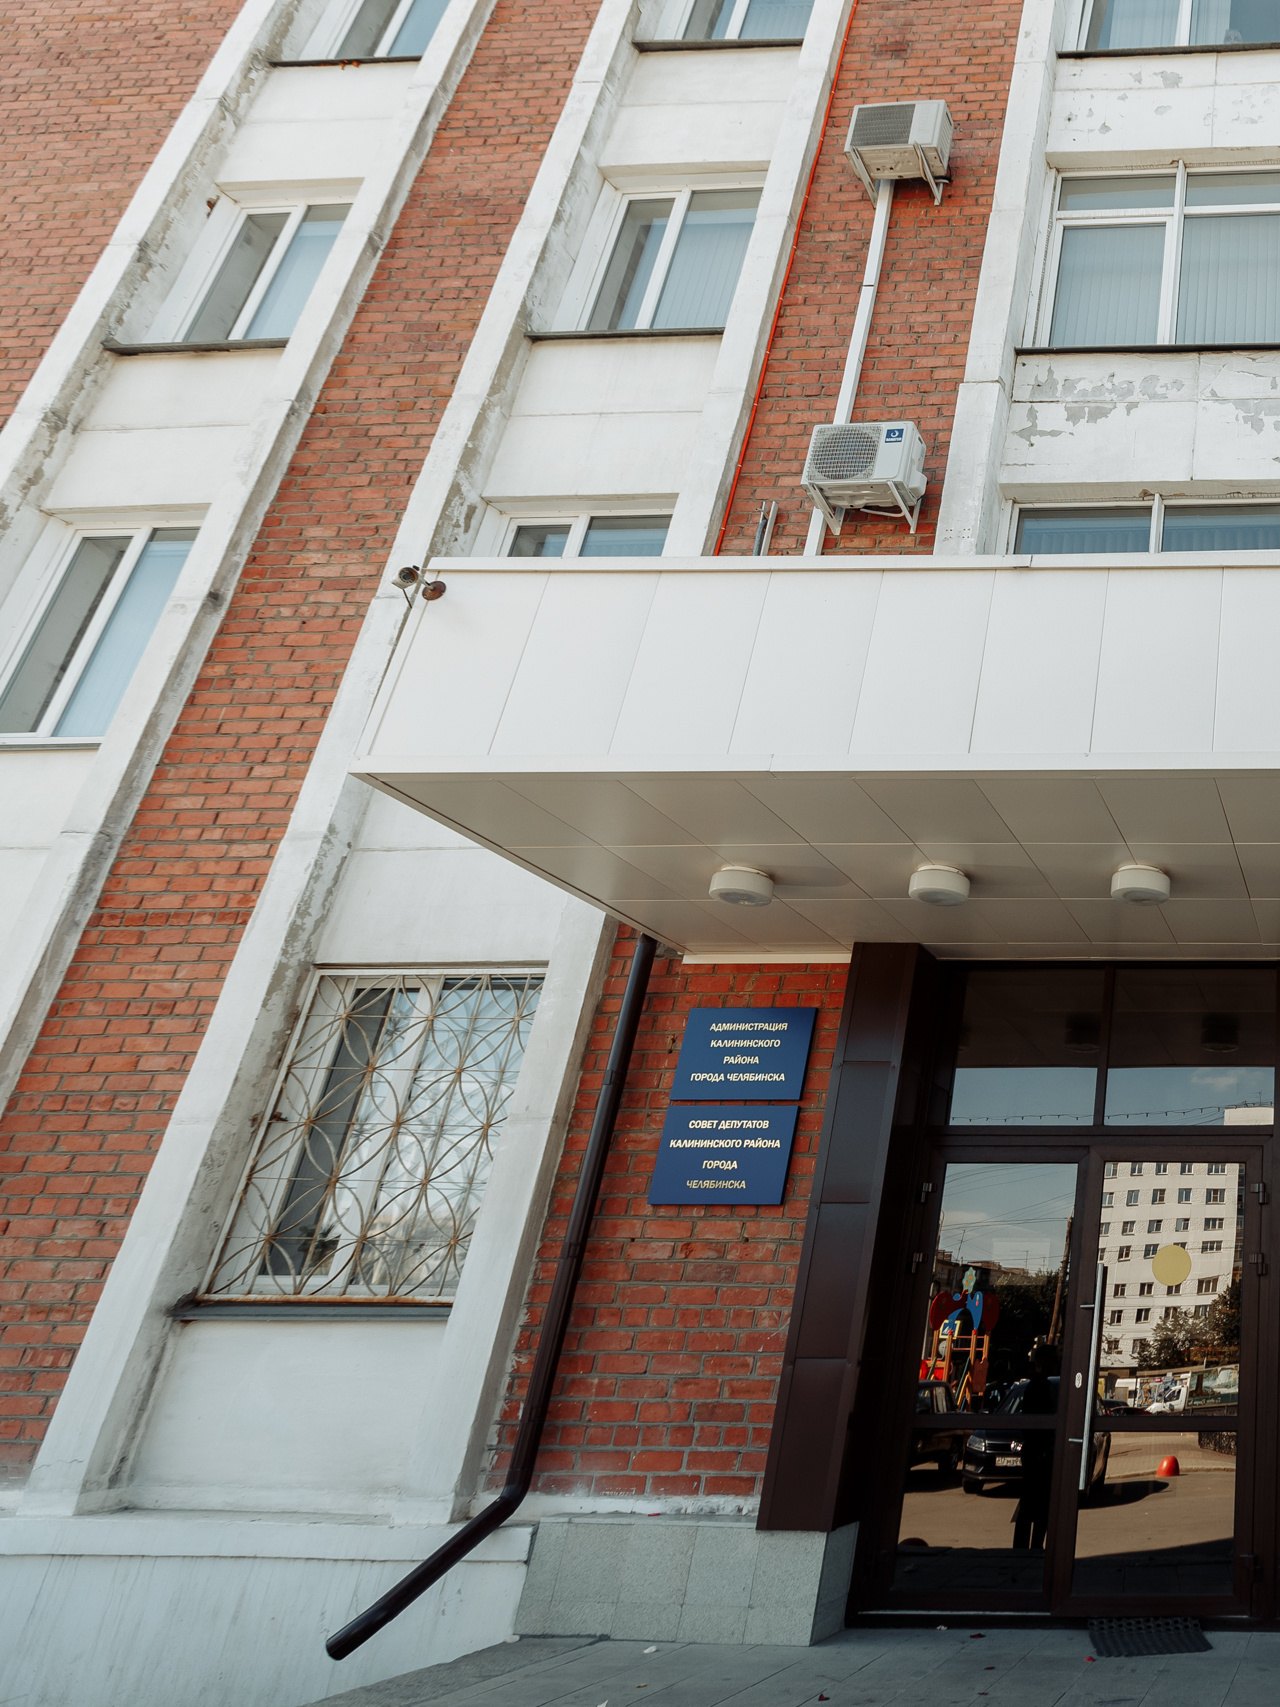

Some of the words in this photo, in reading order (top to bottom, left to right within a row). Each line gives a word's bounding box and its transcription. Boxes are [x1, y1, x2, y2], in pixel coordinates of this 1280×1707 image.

[710, 1023, 788, 1032] АДМИНИСТРАЦИЯ
[710, 1040, 780, 1048] КАЛИНИНСКОГО
[723, 1055, 759, 1064] РАЙОНА
[690, 1073, 724, 1082] ГОРОДА
[727, 1073, 785, 1081] ЧЕЛЯБИНСКА
[689, 1120, 718, 1128] СОВЕТ
[718, 1120, 769, 1129] ДЕПУТАТОВ
[669, 1140, 742, 1148] КАЛИНИНСКОГО
[744, 1138, 780, 1148] РАЙОНА
[702, 1161, 738, 1170] ГОРОДА
[686, 1180, 746, 1189] ЧЕЛЯБИНСКА
